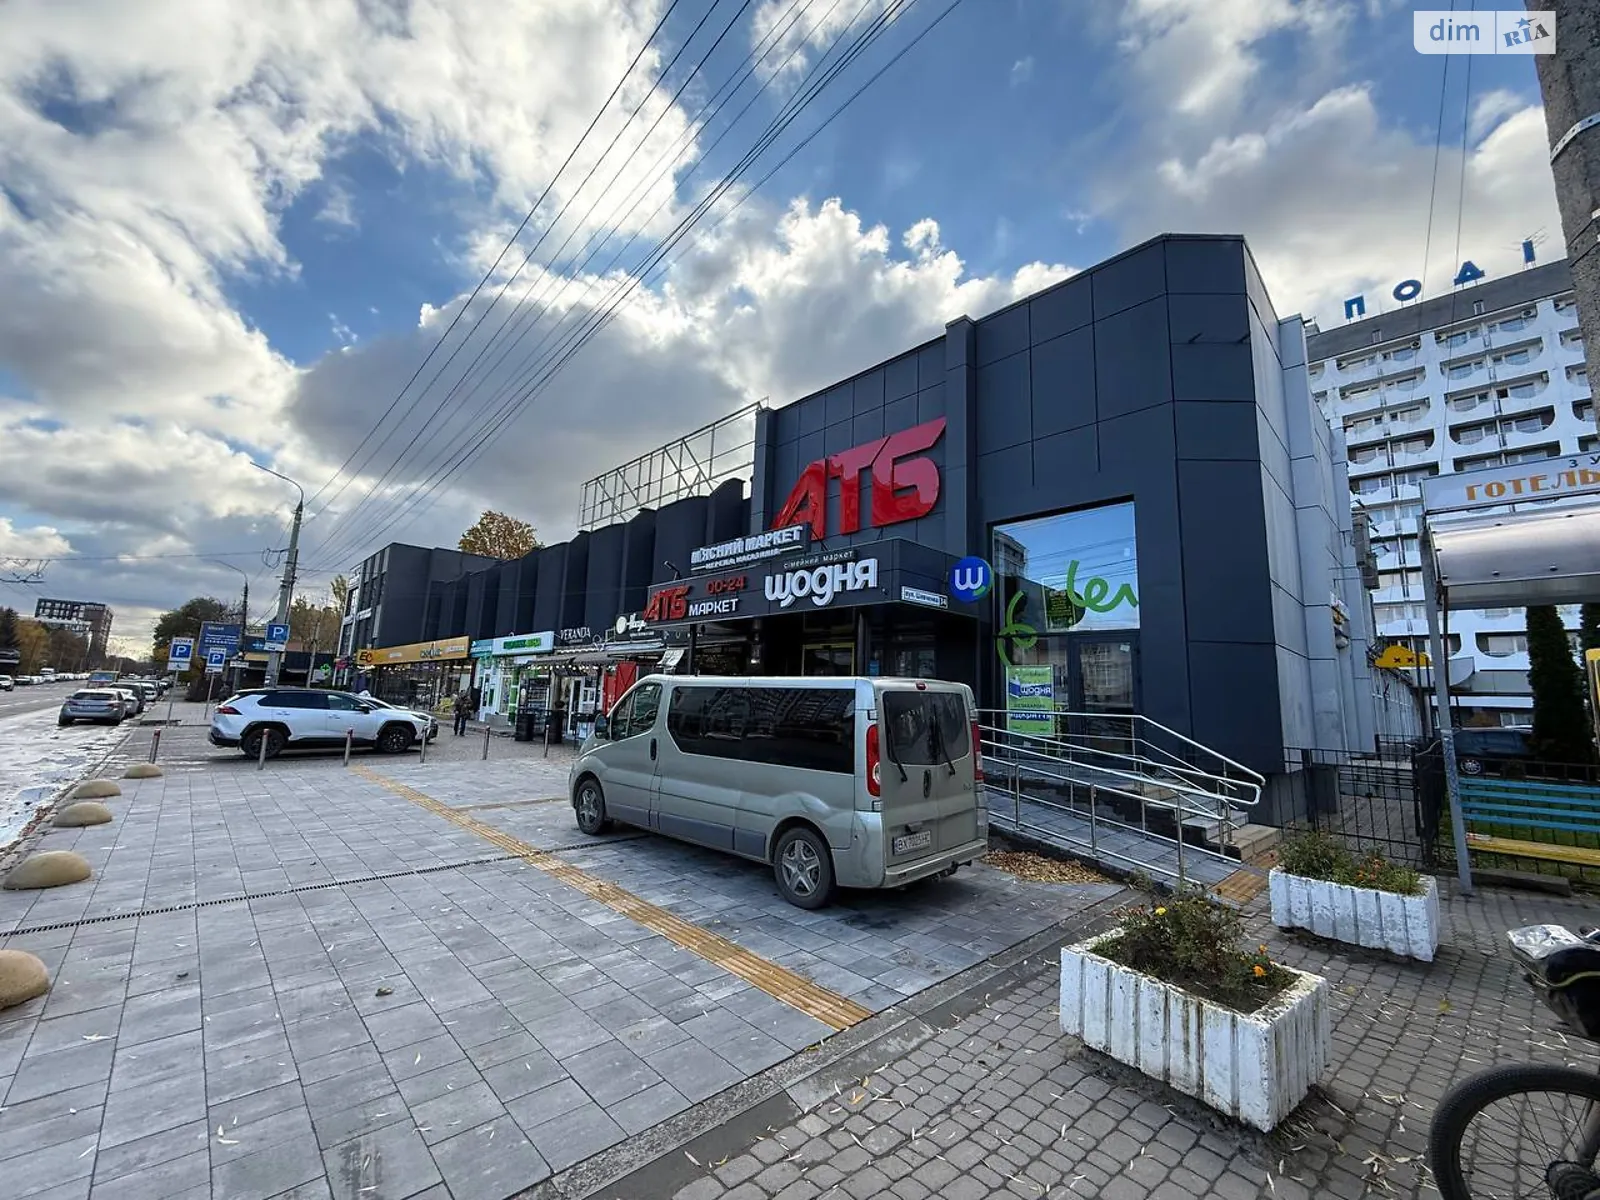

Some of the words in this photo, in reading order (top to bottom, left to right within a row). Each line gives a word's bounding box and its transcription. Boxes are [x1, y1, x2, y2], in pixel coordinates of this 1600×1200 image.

[770, 415, 947, 542] АТБ
[1465, 468, 1600, 501] ГОТЕЛЬ
[744, 524, 803, 552] МАРКЕТ
[704, 576, 747, 596] 00-24
[643, 584, 690, 622] АТБ
[689, 597, 739, 617] МАРКЕТ
[272, 626, 285, 639] P
[175, 645, 188, 657] P
